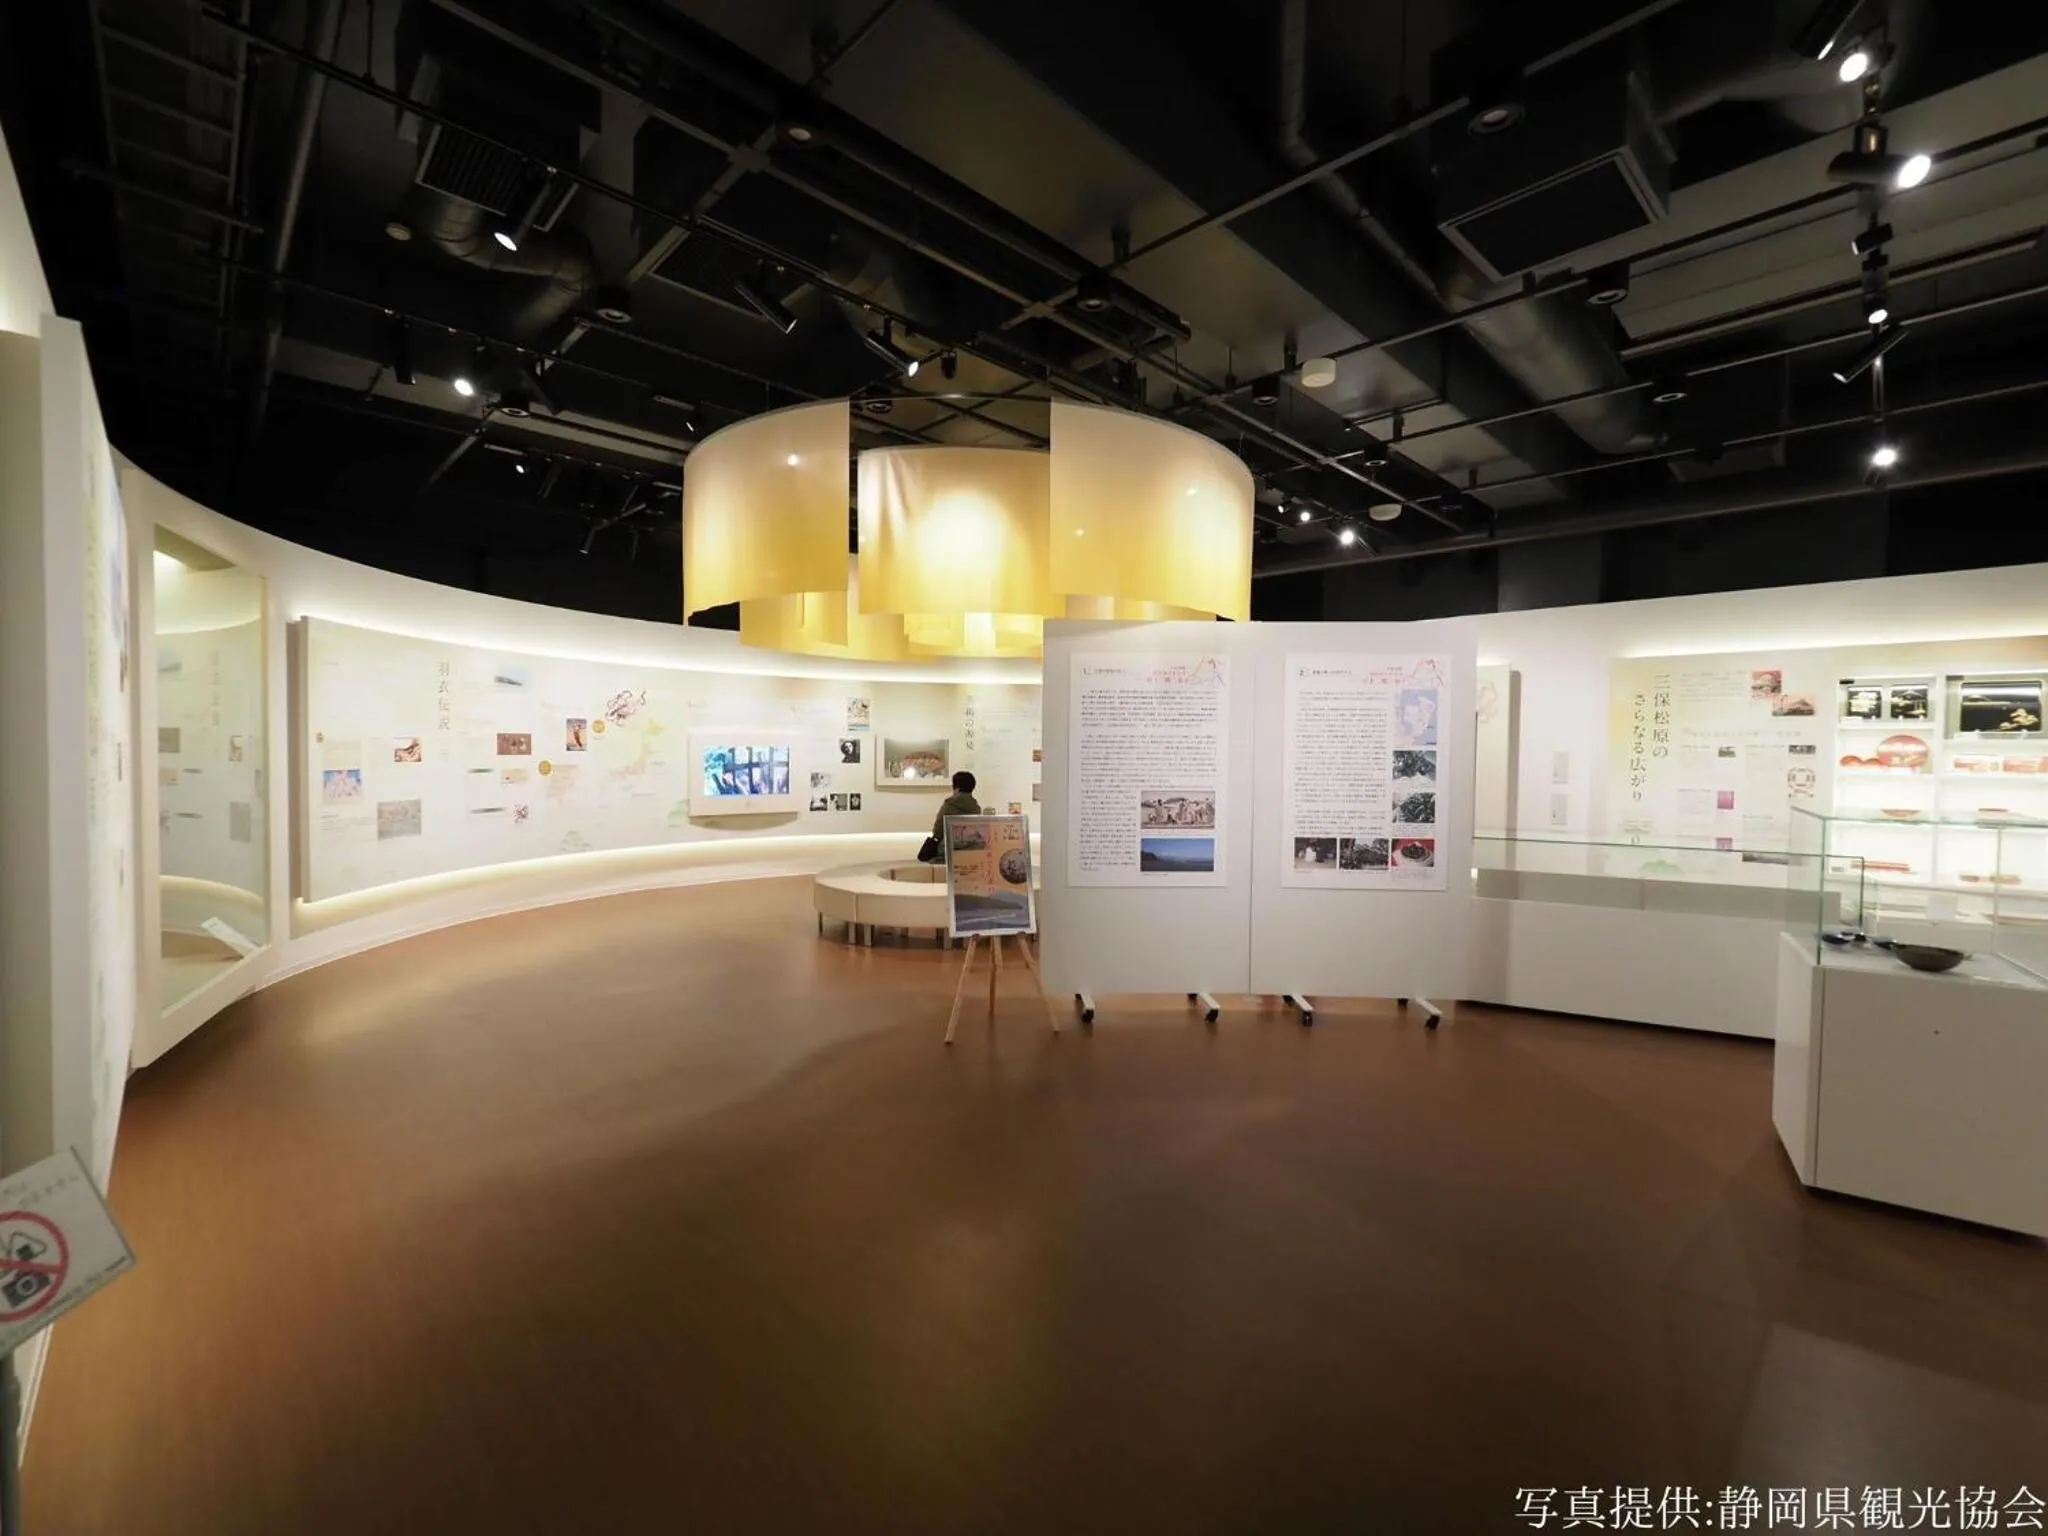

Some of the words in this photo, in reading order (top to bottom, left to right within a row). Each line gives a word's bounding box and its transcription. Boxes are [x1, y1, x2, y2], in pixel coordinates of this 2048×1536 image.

[1629, 693, 1647, 802] さらなる広がり
[1652, 673, 1672, 758] 三保松原の
